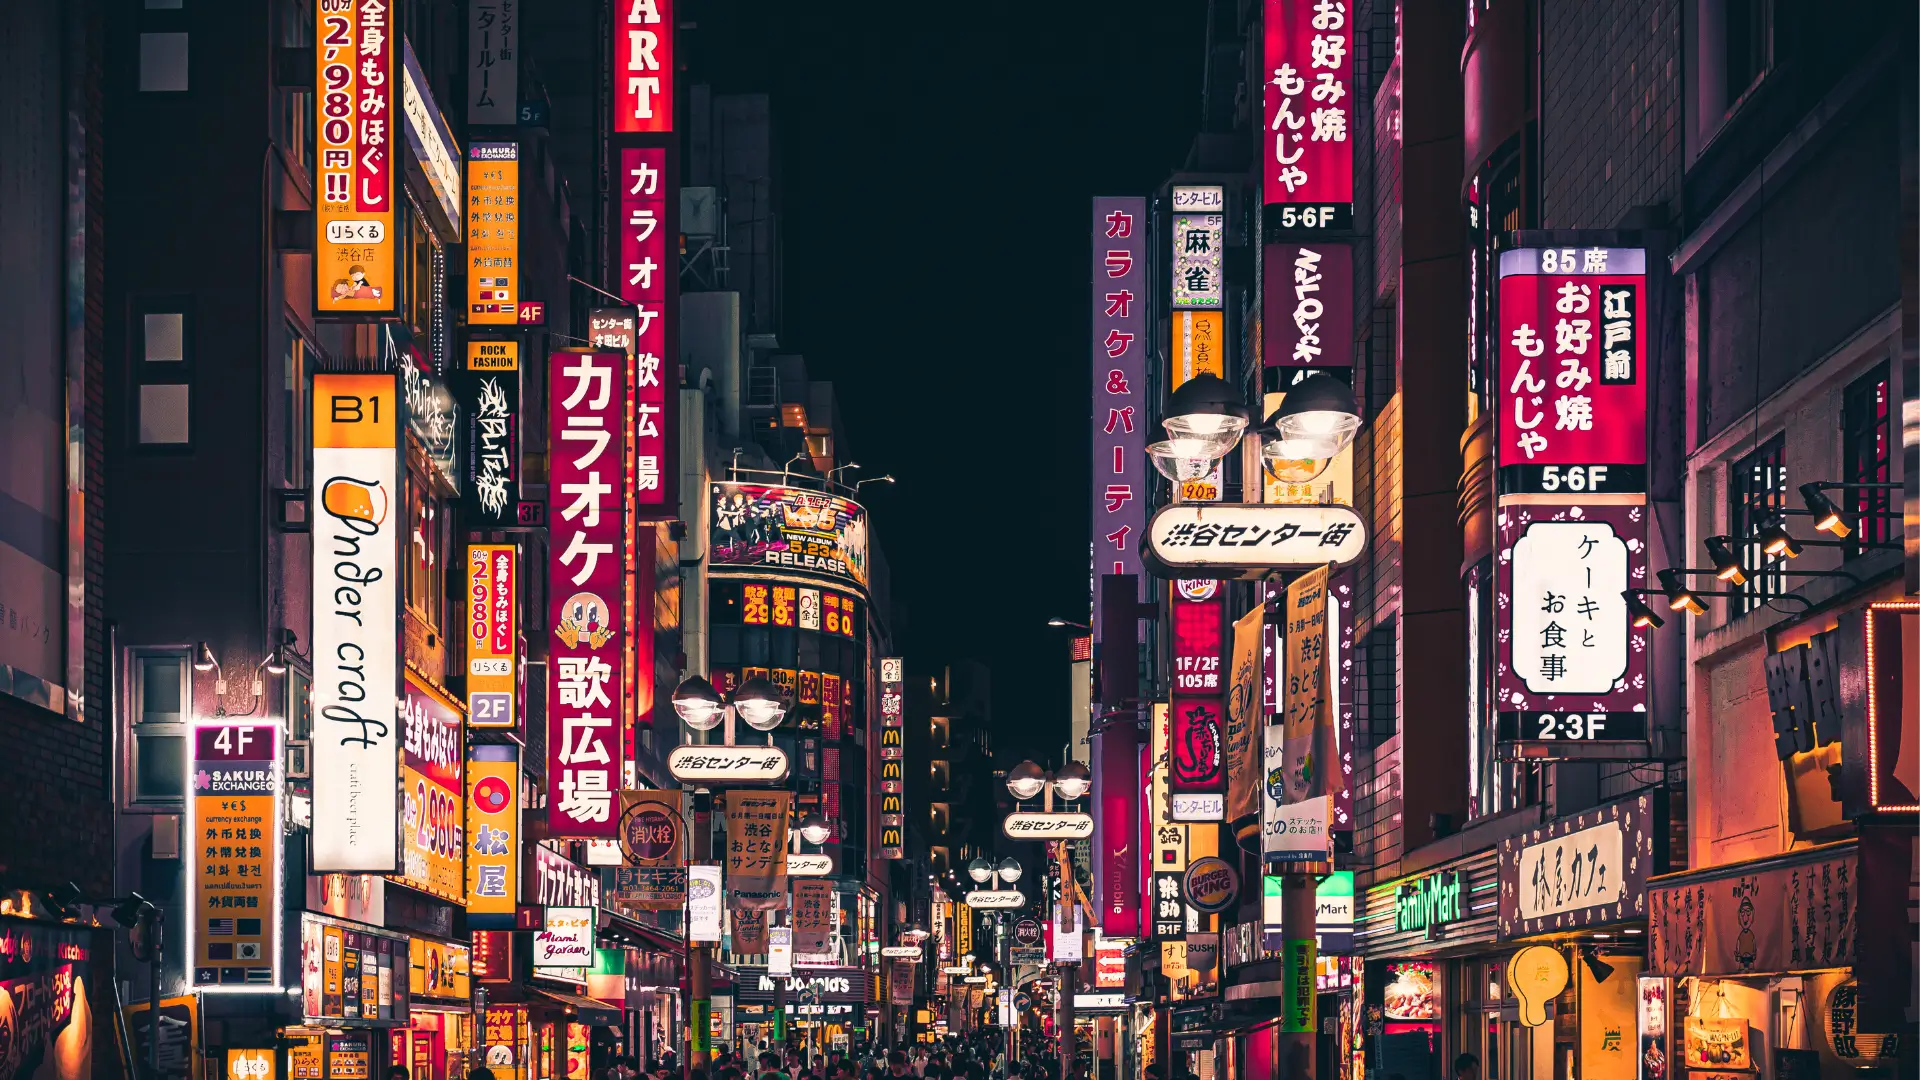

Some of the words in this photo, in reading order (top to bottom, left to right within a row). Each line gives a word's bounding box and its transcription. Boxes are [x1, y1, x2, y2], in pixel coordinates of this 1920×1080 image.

[626, 0, 661, 119] ART
[1311, 0, 1347, 143] お好み焼
[360, 0, 386, 205] 全身もみほぐし
[1271, 63, 1308, 193] もんじゃ
[1207, 216, 1222, 226] 5F
[332, 225, 379, 240] りらくる
[336, 248, 375, 262] 渋谷店
[1185, 228, 1211, 293] 麻雀
[520, 306, 542, 321] 4F
[592, 318, 633, 330] センター街
[1603, 289, 1631, 381] 江戸前
[480, 345, 507, 355] ROCK
[1554, 281, 1593, 432] お好み焼
[473, 357, 513, 367] FASHION
[1510, 323, 1549, 460] もんじゃ
[331, 395, 379, 424] B1
[559, 355, 614, 586] カラオケ
[1273, 484, 1312, 497] 北海道
[521, 505, 542, 522] 3F
[786, 533, 806, 542] NEW
[807, 536, 833, 547] ALBUM
[1161, 522, 1356, 548] 渋谷センター街
[789, 540, 830, 558] 5.23
[765, 550, 847, 575] RELEASE
[1576, 534, 1600, 648] ケーキと
[495, 554, 509, 650] 全身もみほぐし
[1539, 590, 1568, 682] お食事
[1176, 656, 1219, 671] 1F/2F
[1177, 674, 1218, 689] 105席
[476, 698, 507, 719] 2F
[213, 726, 255, 756] 4F
[404, 693, 461, 780] 全身もみほぐし
[557, 655, 613, 824] 歌広場
[675, 755, 780, 770] 渋谷センター街
[212, 770, 274, 782] SAKURA
[212, 781, 268, 791] EXCHANGE
[744, 823, 773, 837] 渋谷
[1010, 820, 1091, 831] 渋谷センター街
[1289, 817, 1323, 825] ステッカー
[631, 825, 672, 845] 消火栓
[731, 839, 784, 853] おとなり
[472, 823, 510, 897] 松屋
[731, 856, 784, 869] サンデー
[1191, 868, 1229, 886] BURGER
[734, 889, 782, 899] Panasonic
[1193, 877, 1231, 901] KING
[1395, 871, 1461, 940] FamilyMart
[523, 910, 540, 927] 1F
[535, 931, 578, 942] Miami
[1017, 928, 1038, 938] 消火栓
[1157, 924, 1182, 935] B1F
[58, 941, 90, 962] Kitchen
